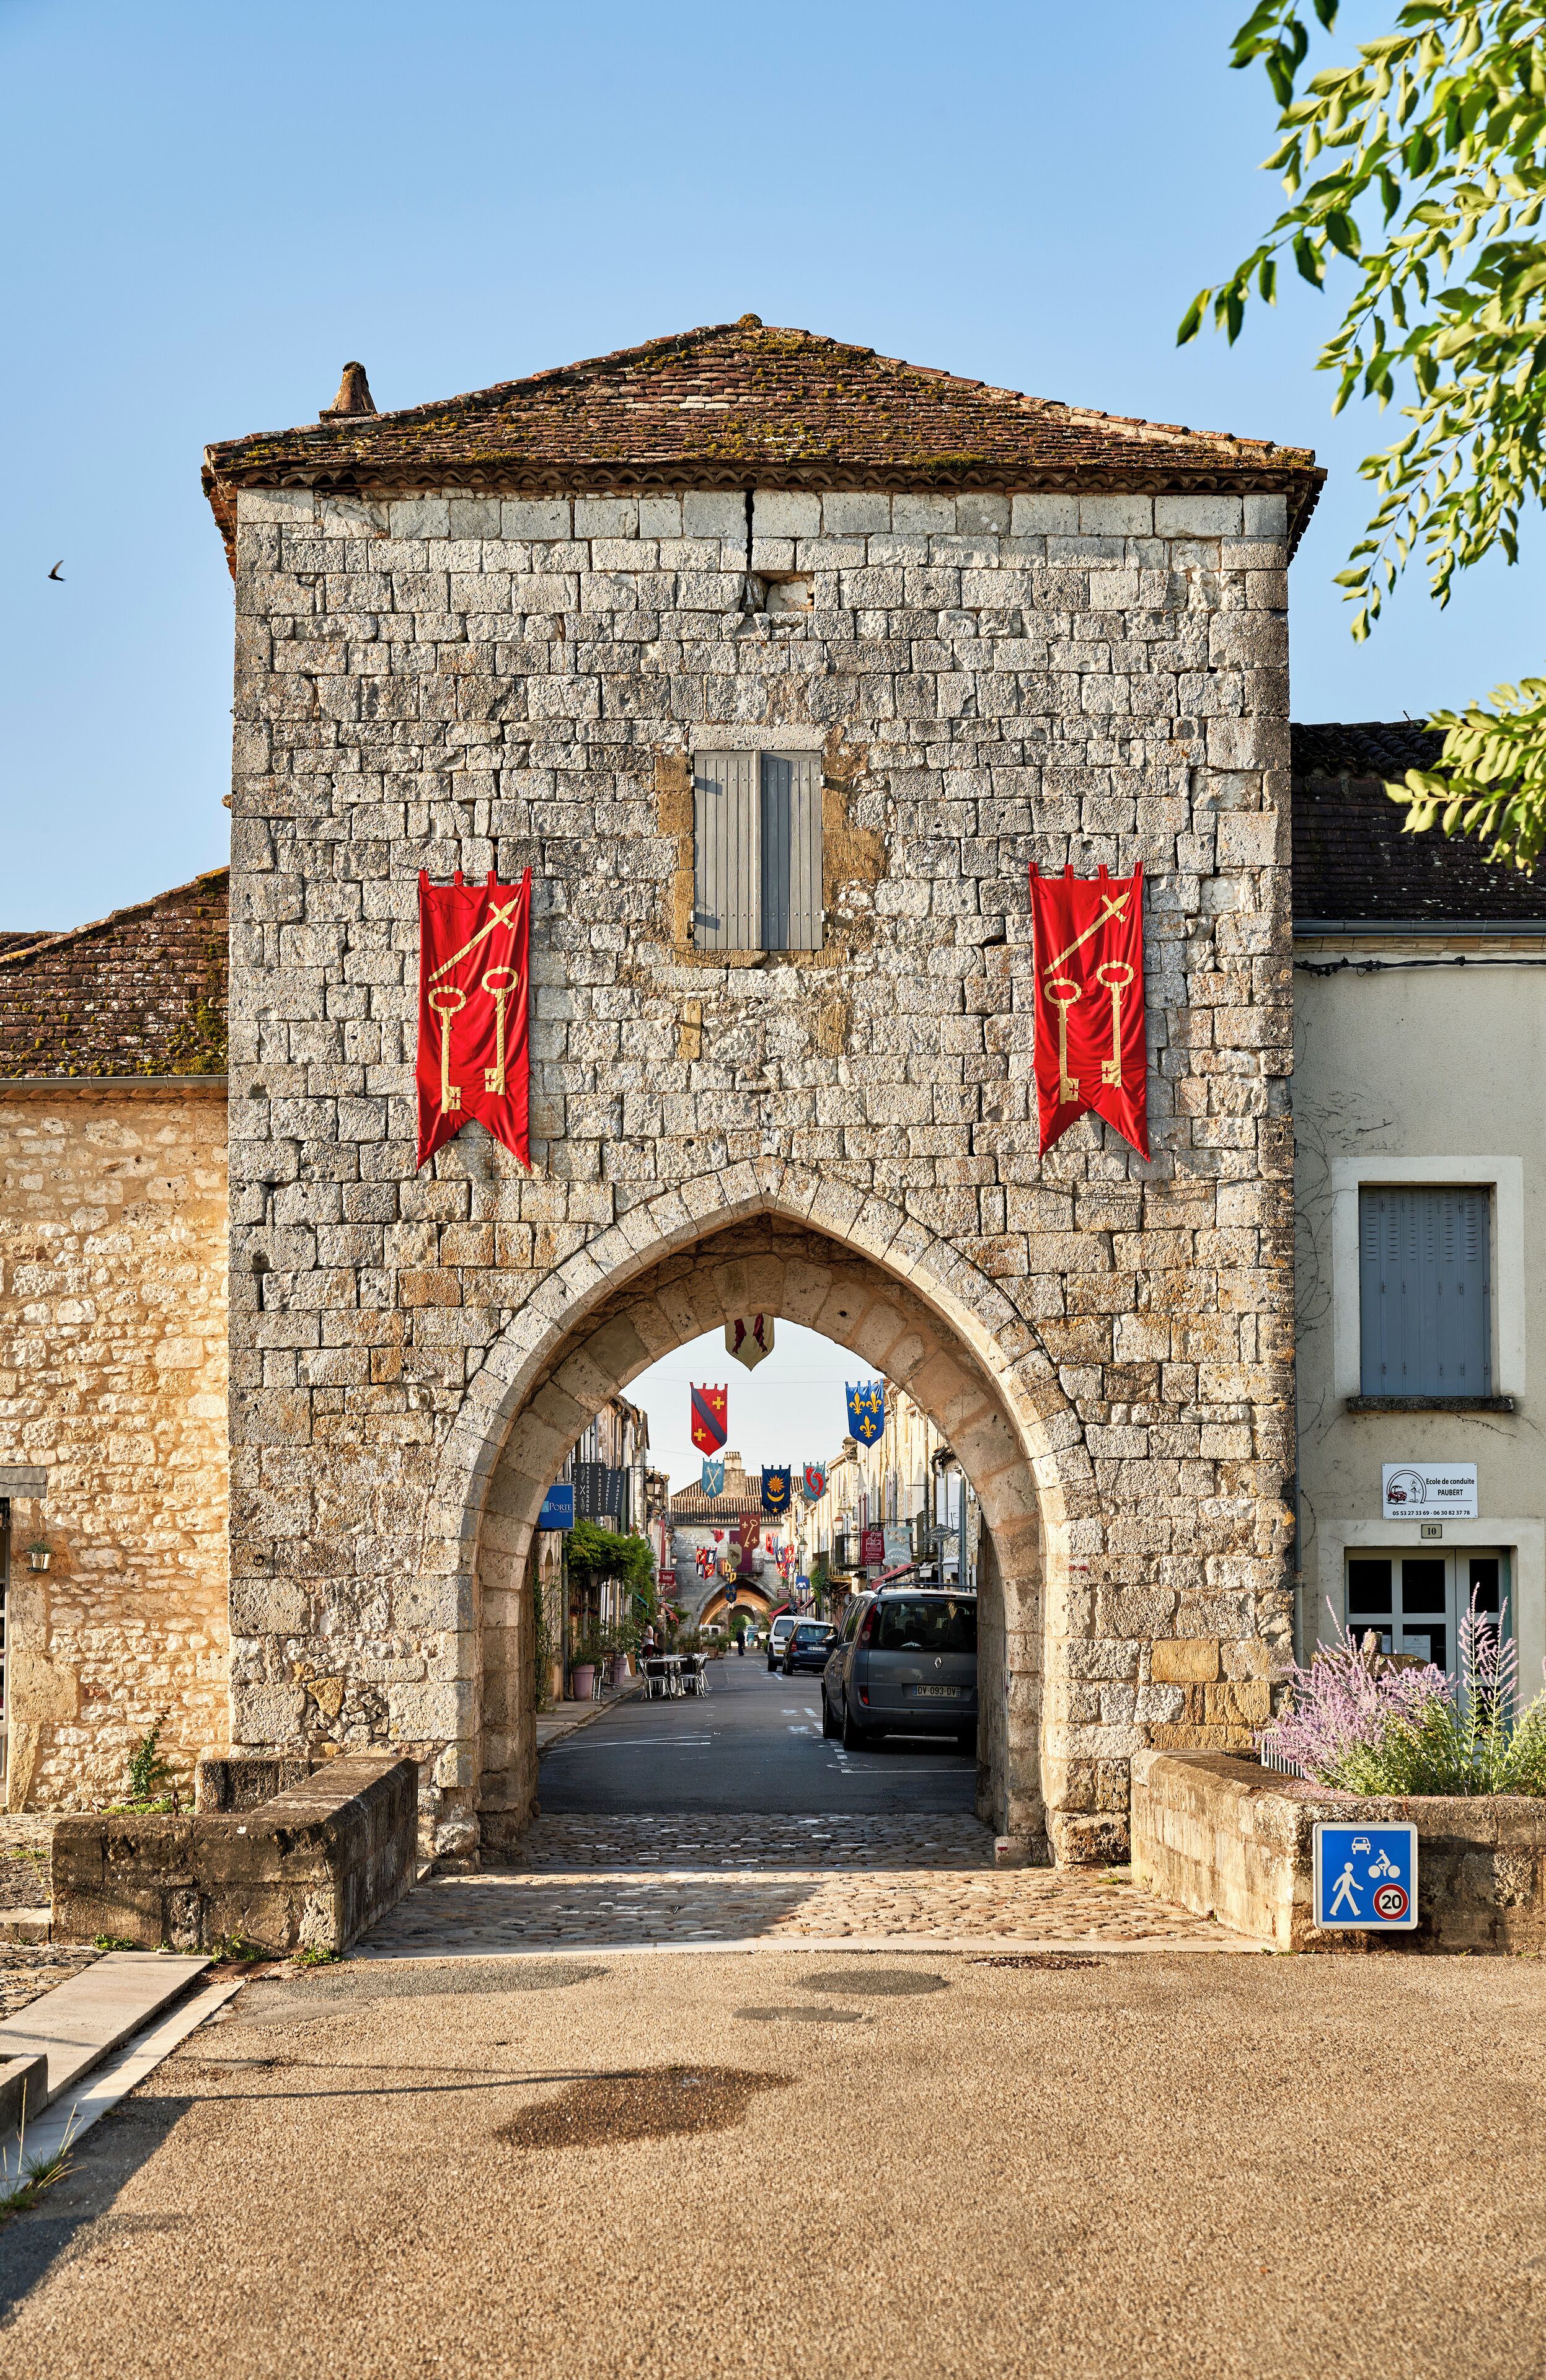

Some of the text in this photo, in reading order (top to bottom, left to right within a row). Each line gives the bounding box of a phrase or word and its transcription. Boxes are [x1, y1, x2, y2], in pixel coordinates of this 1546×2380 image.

[598, 1467, 602, 1476] LA
[617, 1475, 621, 1483] LA
[1426, 1527, 1437, 1535] 10
[917, 1686, 956, 1696] DV-093-DV
[1382, 1894, 1402, 1910] 20
